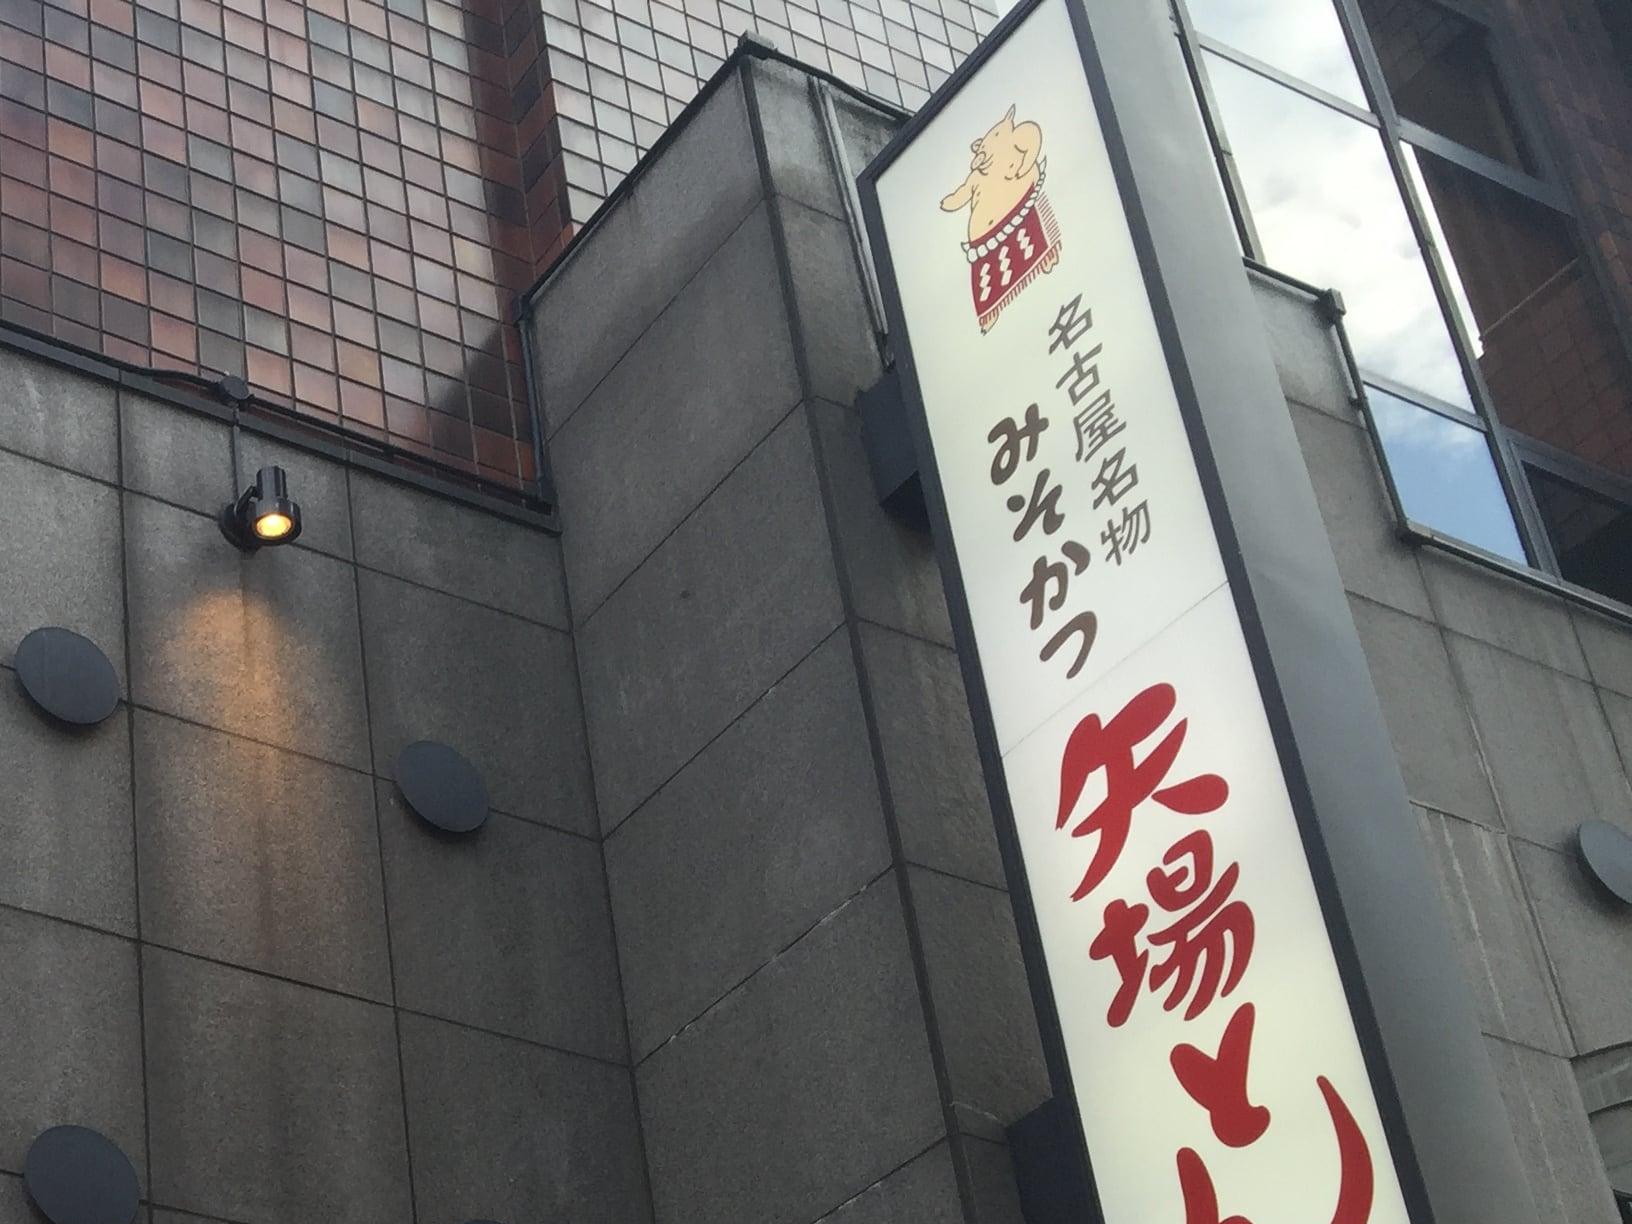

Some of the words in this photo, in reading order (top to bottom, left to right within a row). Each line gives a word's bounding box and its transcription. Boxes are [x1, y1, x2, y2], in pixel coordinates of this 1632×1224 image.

[986, 403, 1098, 680] みそかつ
[1048, 293, 1151, 566] 名古屋名物
